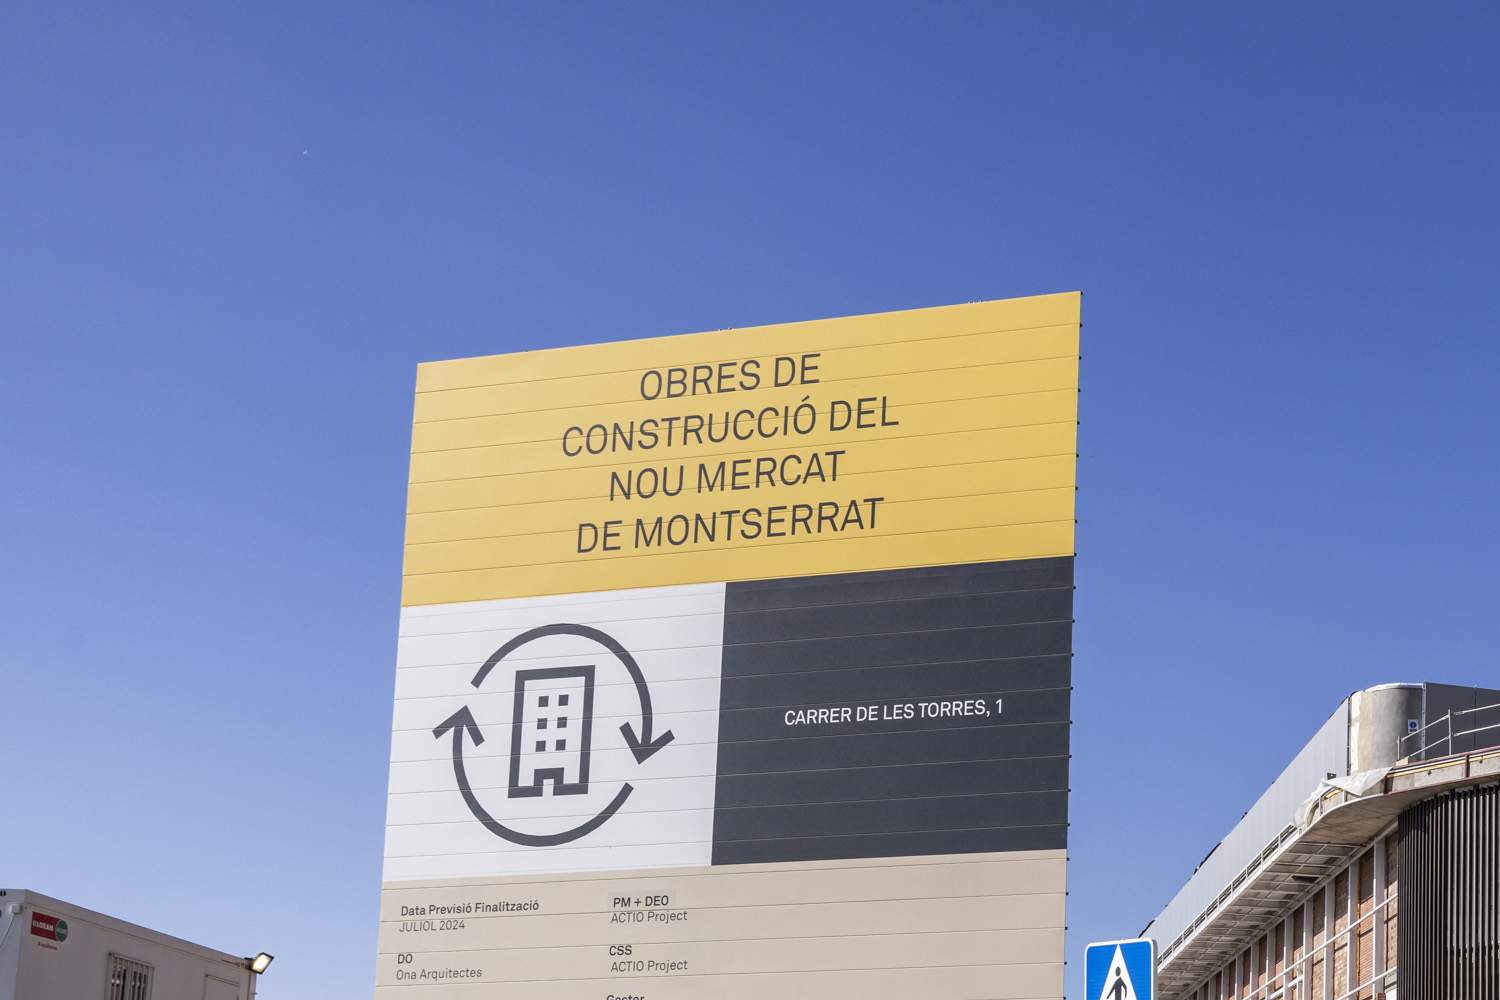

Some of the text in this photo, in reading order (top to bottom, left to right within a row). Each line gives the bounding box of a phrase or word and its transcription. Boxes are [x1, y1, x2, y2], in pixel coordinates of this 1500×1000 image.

[640, 353, 821, 401] OBRES DE
[562, 396, 899, 458] CONSTRUCCIÓ DEL
[608, 450, 846, 503] NOU MERCAT
[576, 497, 885, 554] DE MONTSERRAT
[784, 698, 1004, 726] CARRER DE LES TORRES, 1
[401, 900, 540, 917] Data Previsió Finalització
[613, 895, 670, 909] PM + DEO
[611, 911, 688, 925] ACTIO Project
[399, 920, 465, 933] JULIOL 2024
[609, 945, 633, 957] CSS
[397, 953, 413, 965] DO
[611, 960, 688, 974] ACTIO Project
[396, 968, 483, 982] Ona Arquitectes
